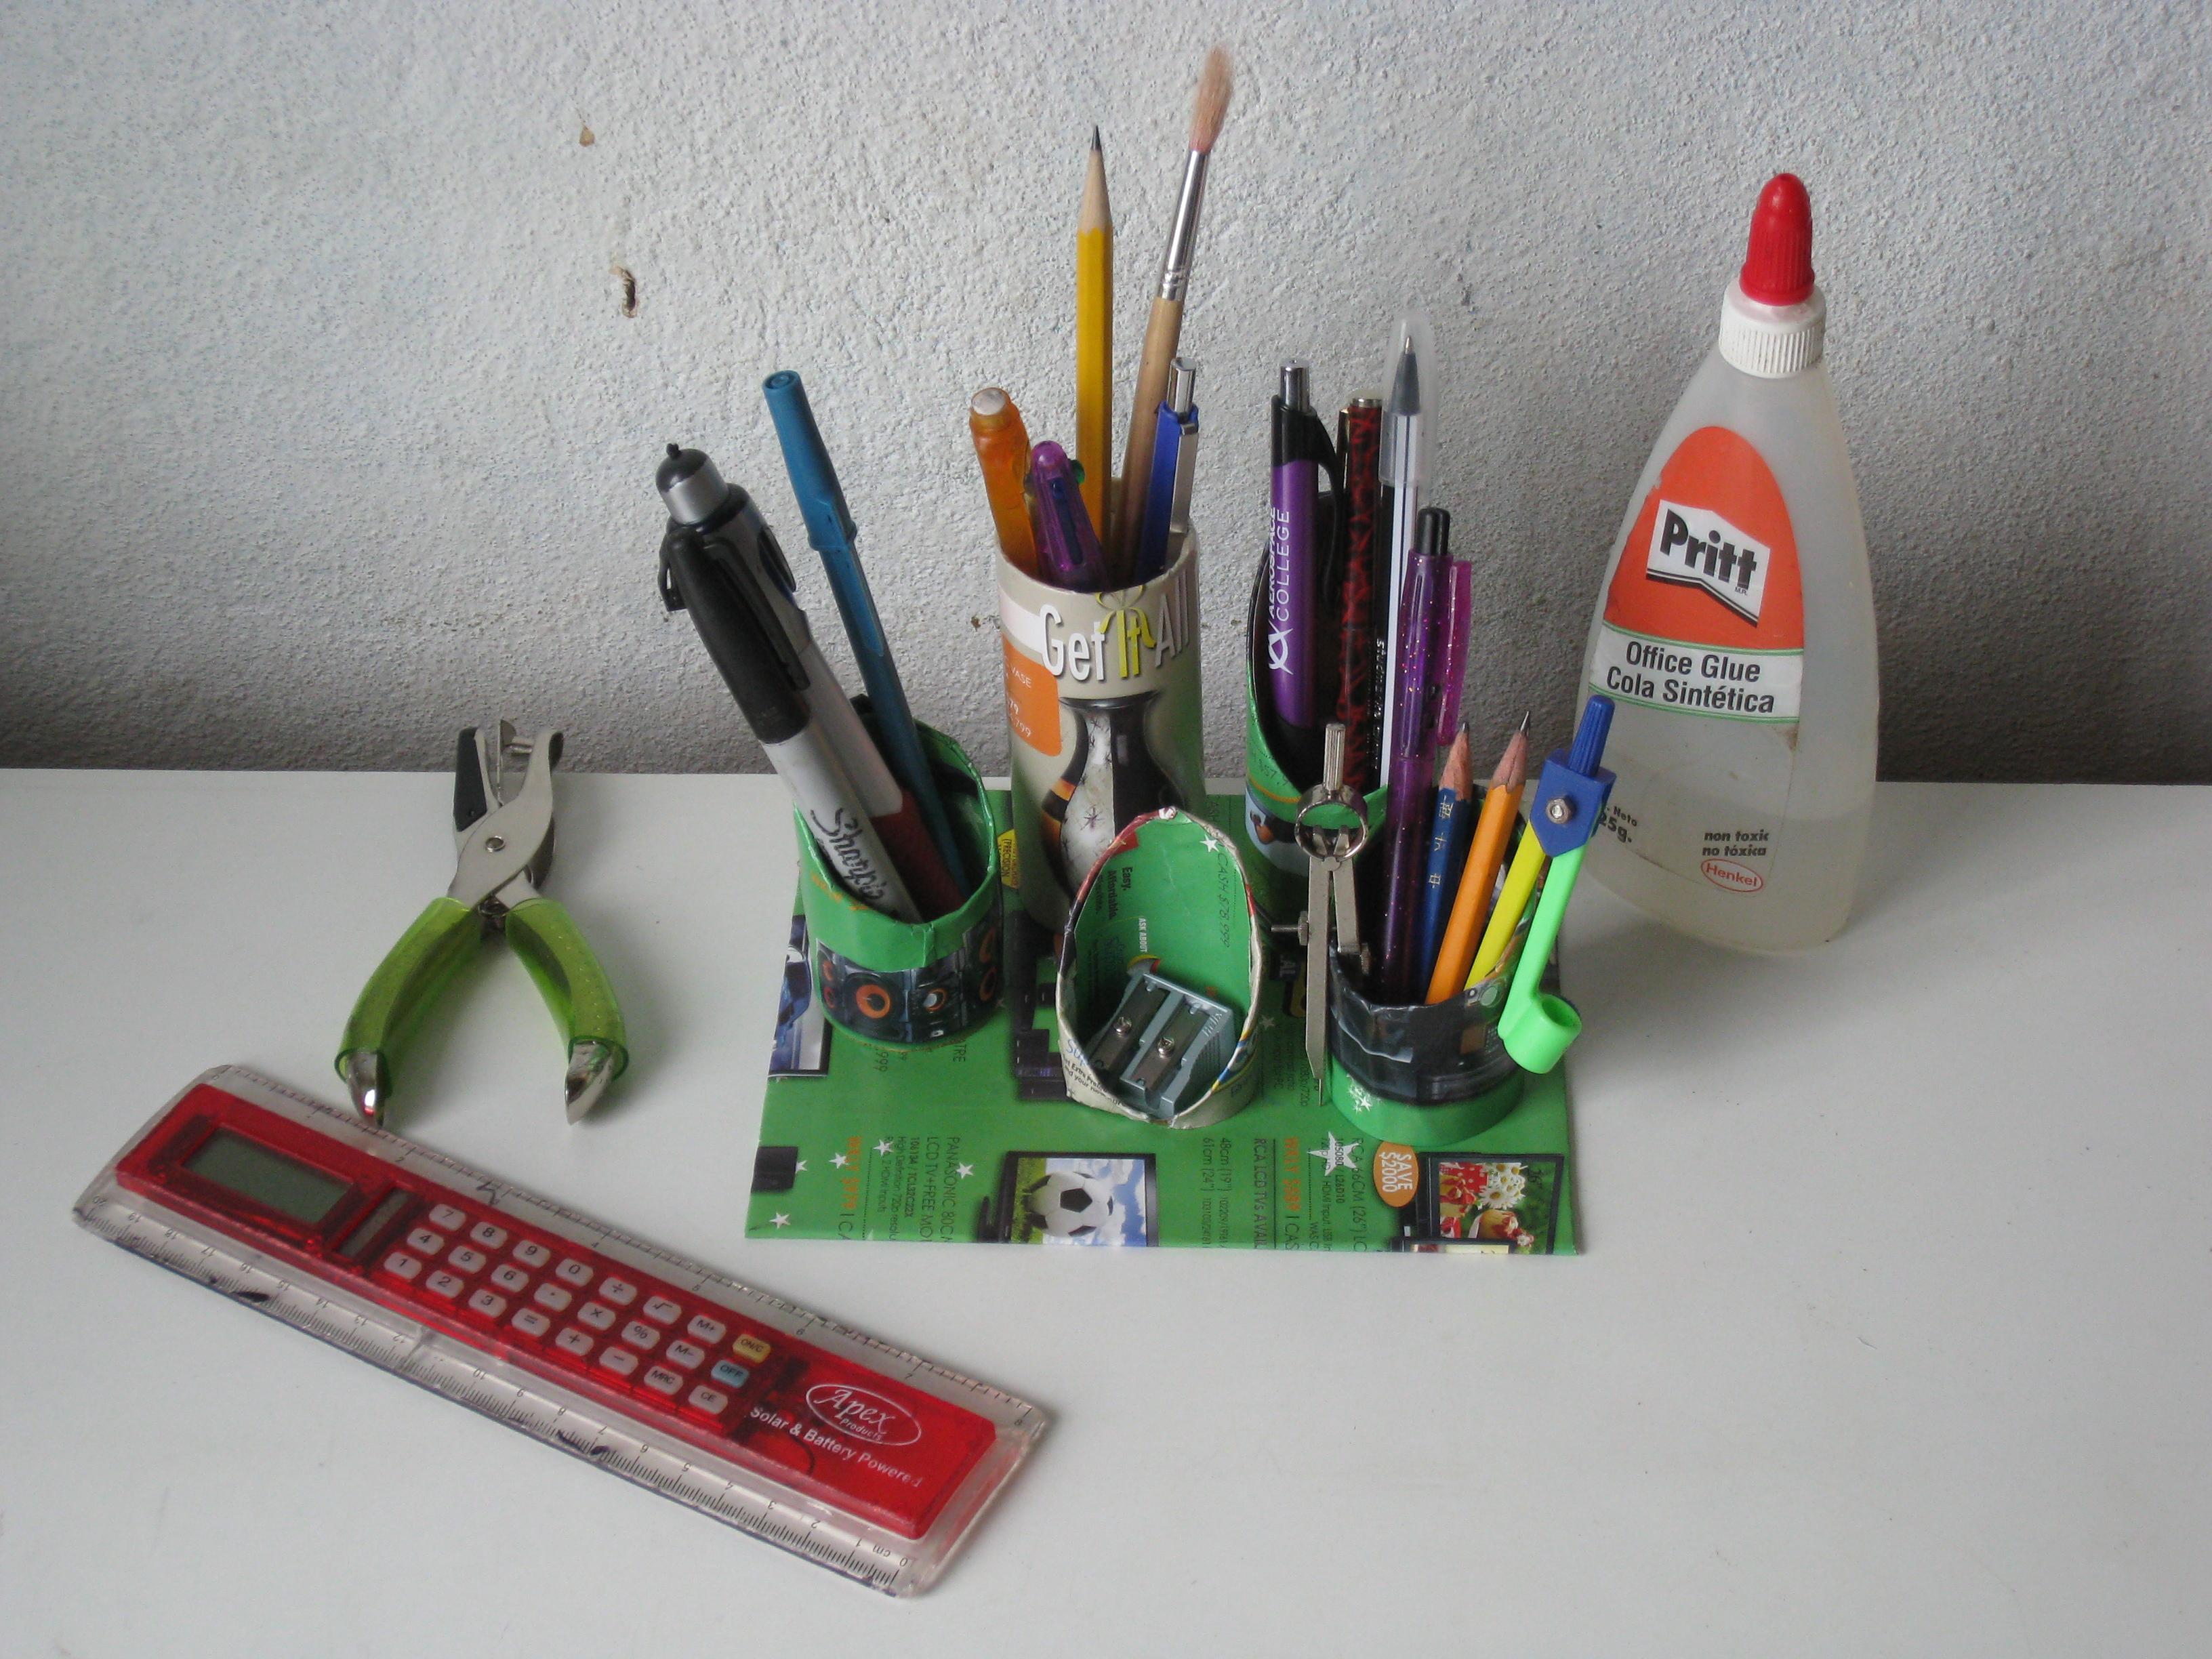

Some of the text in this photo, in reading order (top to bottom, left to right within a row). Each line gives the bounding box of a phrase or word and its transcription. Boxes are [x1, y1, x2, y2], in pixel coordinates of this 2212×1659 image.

[1660, 508, 1758, 590] Pritt
[1276, 510, 1290, 622] COLLEGE
[1040, 603, 1106, 681] Get
[1154, 569, 1190, 668] All
[1626, 640, 1761, 683] Office Glue
[1606, 665, 1776, 713] Cola Sintética
[1613, 806, 1638, 827] Neto
[1703, 828, 1770, 842] non toxic
[1702, 843, 1767, 857] no tóxica
[1218, 853, 1229, 895] CASH
[1705, 862, 1758, 888] Henkel
[1138, 917, 1148, 954] ASK ABOUT
[846, 1136, 862, 1172] WKLY
[895, 1135, 907, 1153] High
[926, 1136, 940, 1160] LCD
[1202, 1136, 1215, 1165] 61cm
[1218, 1136, 1232, 1165] 48cm
[1253, 1137, 1267, 1162] RCA
[1283, 1136, 1300, 1174] WKLY
[1351, 1136, 1364, 1163] RCA
[941, 1136, 960, 1208] PANASONIC
[1253, 1165, 1267, 1188] LCD
[1351, 1167, 1365, 1202] 66CM
[1378, 1151, 1398, 1193] $2000
[1394, 1153, 1413, 1191] SAVE
[840, 1176, 860, 1210] $979
[921, 1162, 938, 1212] TV+FREE
[1253, 1191, 1267, 1210] TVs
[1321, 1180, 1330, 1202] HDMI
[443, 1208, 455, 1219] 7
[482, 1227, 496, 1238] 8
[525, 1245, 537, 1256] 9
[1308, 1221, 1319, 1240] WAS
[201, 1246, 216, 1258] 17
[315, 1297, 329, 1309] 14
[419, 1233, 432, 1244] 4
[459, 1251, 474, 1263] 5
[503, 1270, 517, 1281] 6
[719, 1364, 744, 1378] OFF
[354, 1314, 368, 1326] 13
[398, 1258, 408, 1267] 1
[437, 1276, 452, 1288] 2
[480, 1294, 494, 1306] 3
[651, 1369, 676, 1385] MRC
[699, 1391, 716, 1402] CE
[473, 1368, 487, 1380] 10
[813, 1389, 897, 1435] Apex
[597, 1425, 608, 1435] 7
[750, 1405, 790, 1430] Solar
[790, 1423, 802, 1437] &
[803, 1428, 858, 1461] Battery
[840, 1418, 882, 1442] Products
[681, 1462, 692, 1472] 5
[723, 1480, 734, 1491] 4
[767, 1500, 777, 1510] 3
[810, 1519, 821, 1529] 2
[872, 1544, 891, 1558] cm
